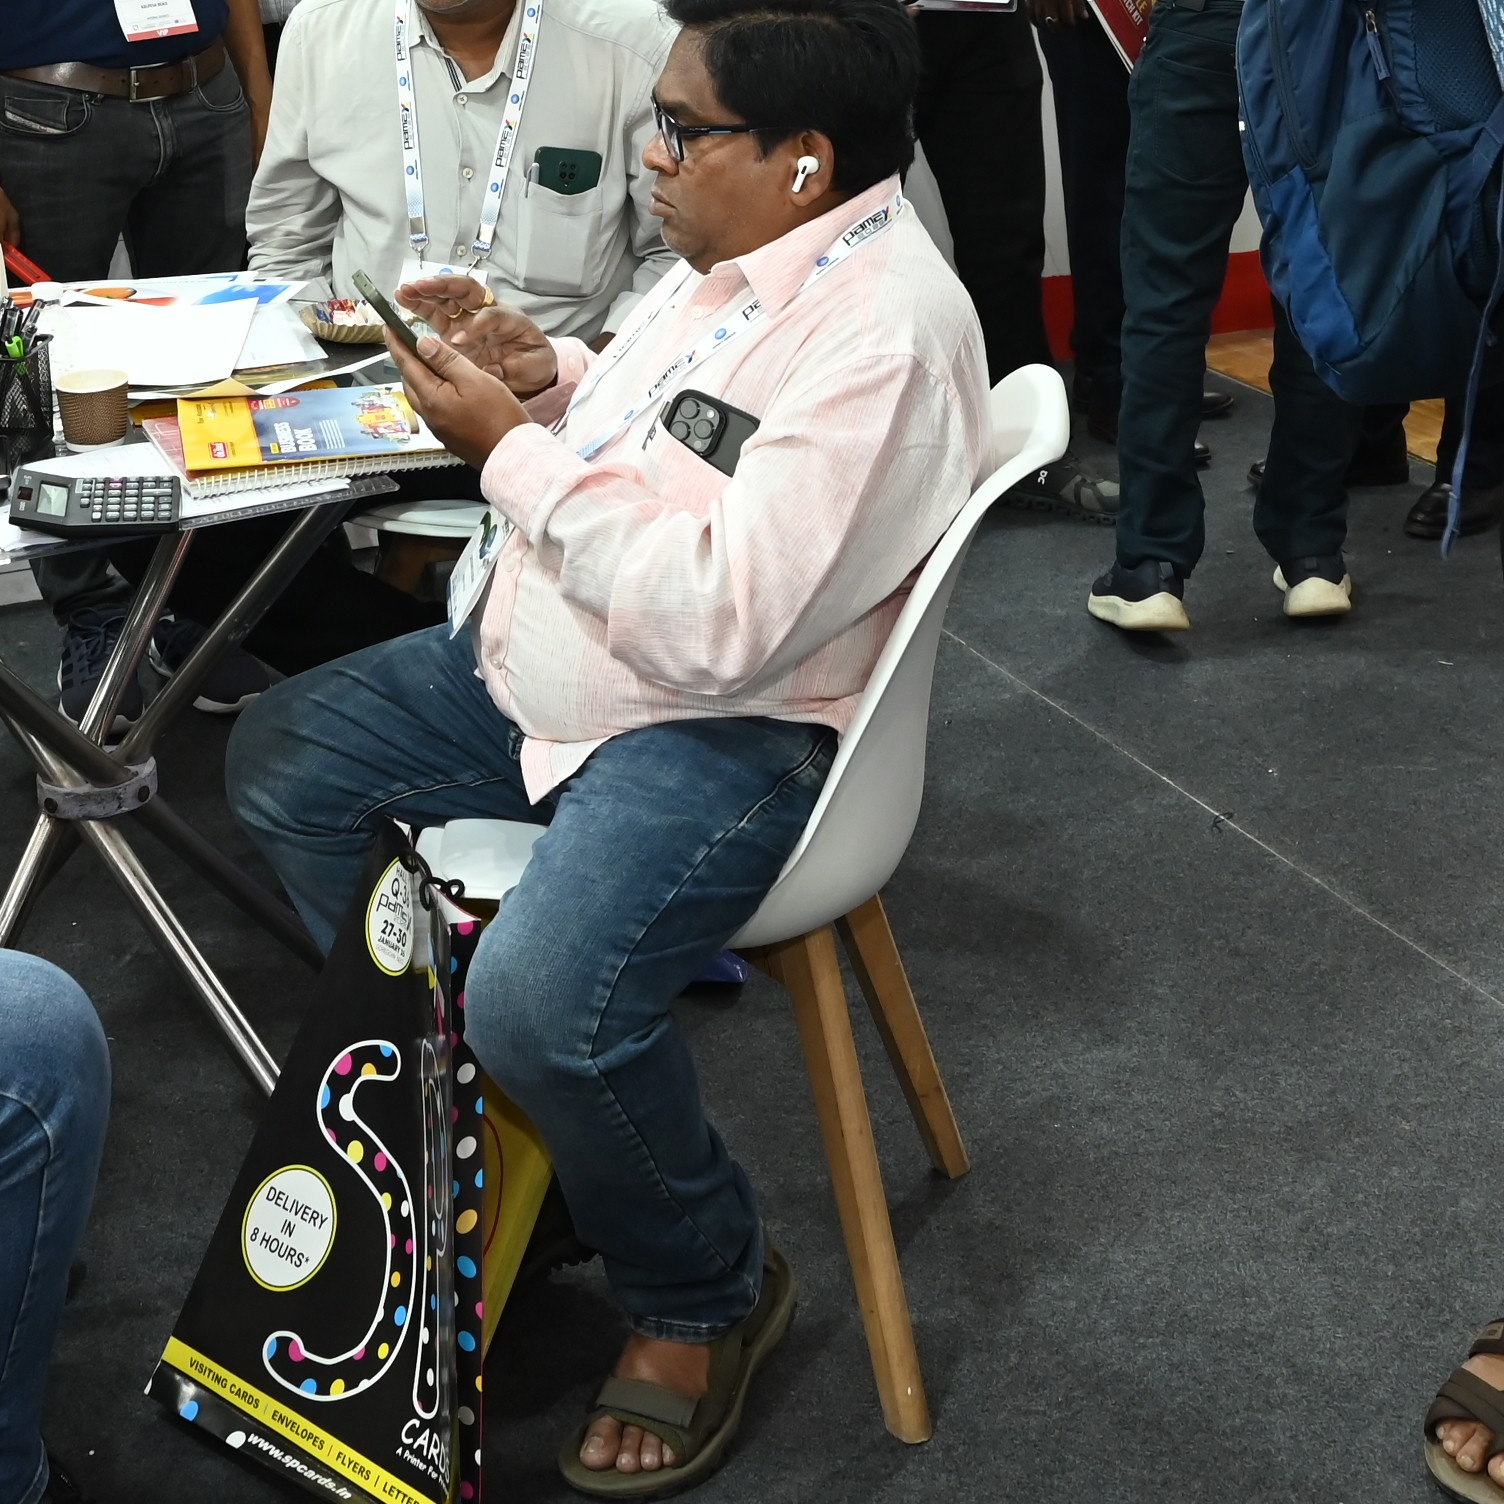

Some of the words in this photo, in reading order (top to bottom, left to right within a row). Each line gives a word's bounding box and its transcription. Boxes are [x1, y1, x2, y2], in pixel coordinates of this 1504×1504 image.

[1131, 8, 1143, 26] KIT
[279, 422, 295, 454] BUSINESS
[297, 428, 317, 453] BOOK
[378, 935, 400, 953] JANUARY
[381, 920, 407, 947] 27-30
[265, 1185, 328, 1231] DELIVERY
[250, 1227, 258, 1242] 8
[281, 1219, 296, 1238] IN
[188, 1356, 229, 1390] VISITING
[229, 1383, 260, 1410] CARDS
[271, 1409, 325, 1452] ENVELOPES
[336, 1451, 371, 1481] FLYERS
[396, 1447, 403, 1456] A
[247, 1432, 353, 1500] www.spcards.in
